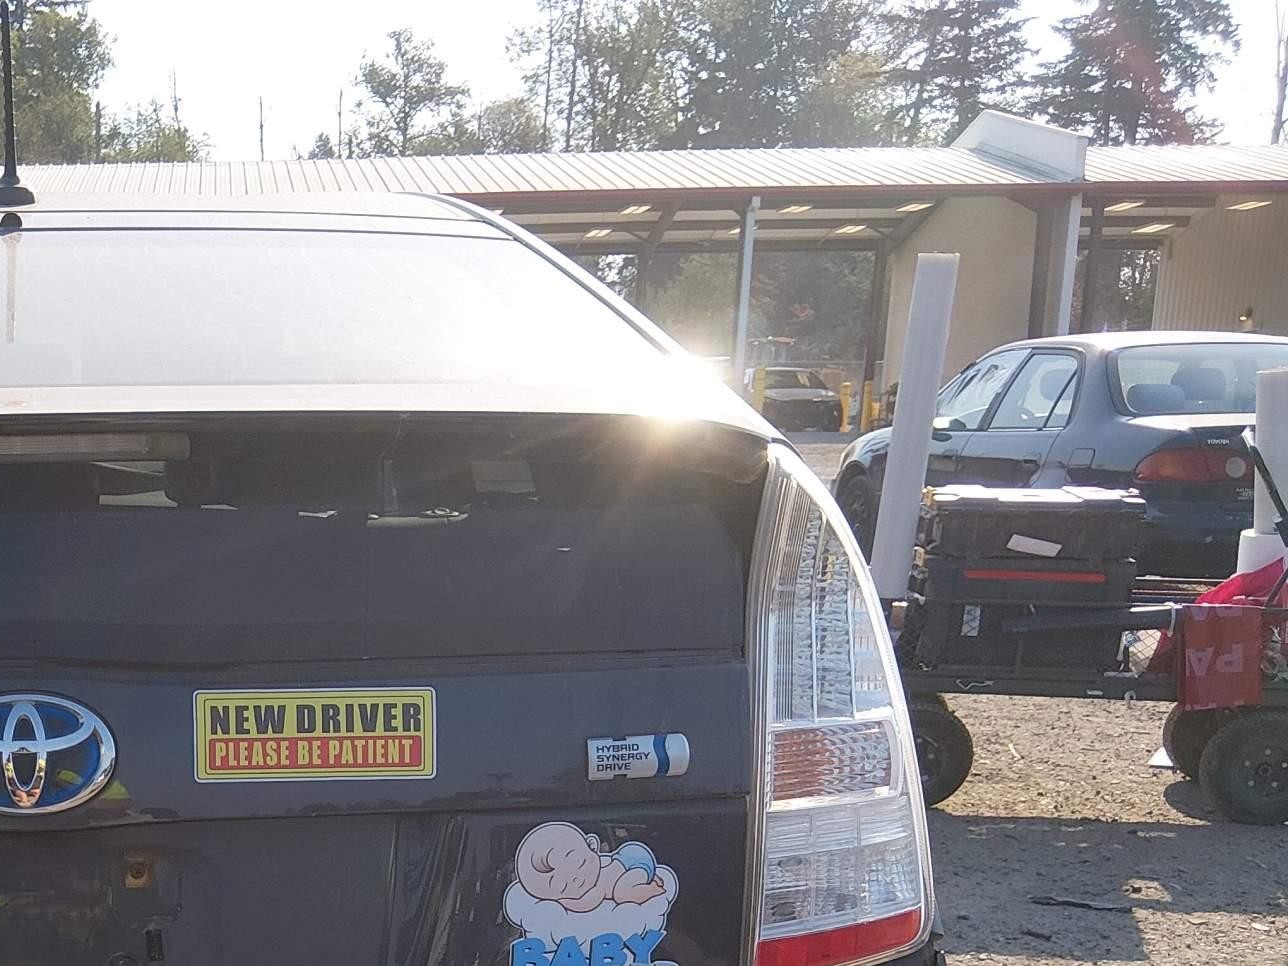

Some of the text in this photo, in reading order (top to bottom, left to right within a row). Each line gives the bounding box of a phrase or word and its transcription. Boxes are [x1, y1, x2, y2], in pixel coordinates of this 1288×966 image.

[209, 702, 422, 736] NEW DRIVER
[214, 739, 414, 766] PLEASE BE PATIENT
[596, 743, 640, 754] HYBRID
[596, 751, 651, 763] SYNERGY
[596, 762, 632, 772] DRIVE
